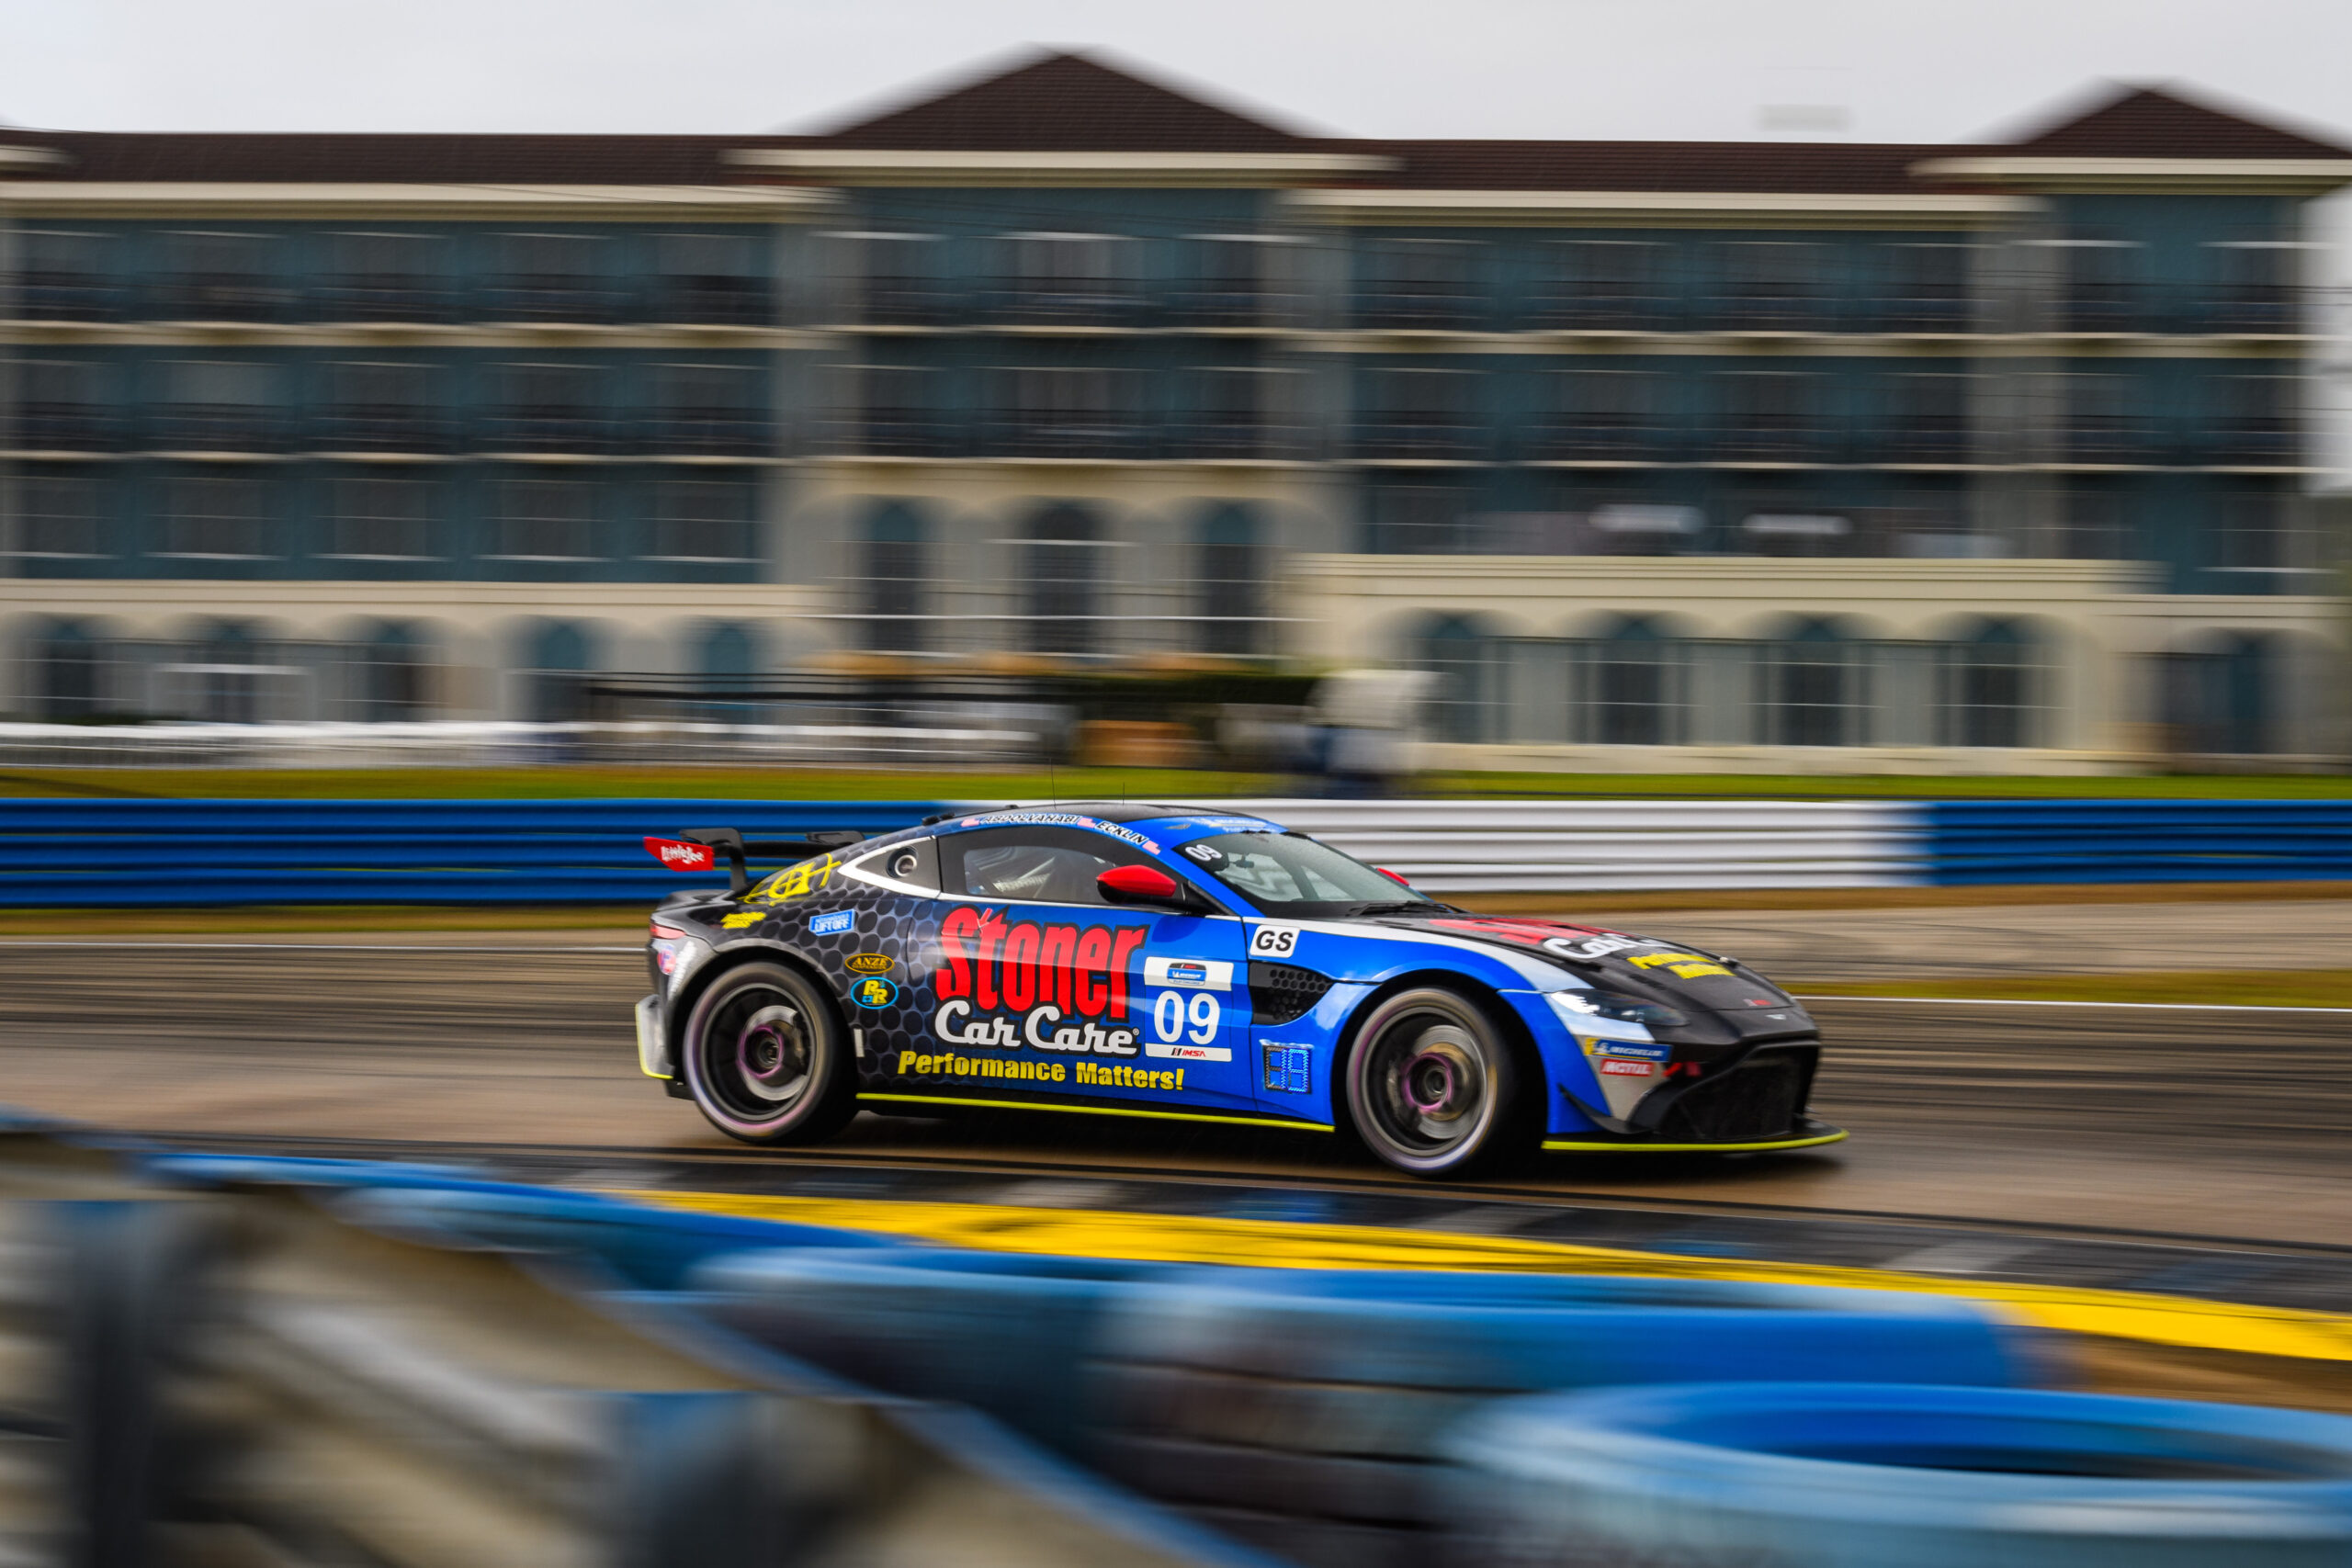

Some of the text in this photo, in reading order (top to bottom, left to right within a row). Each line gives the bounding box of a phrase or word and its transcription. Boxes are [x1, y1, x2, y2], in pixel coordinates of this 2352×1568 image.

[982, 812, 1081, 825] ABDOLVAHABI
[1096, 821, 1148, 843] ECKLIN
[1185, 844, 1223, 862] 09
[1256, 931, 1294, 952] GS
[935, 907, 1146, 1019] Stoner
[935, 1000, 1022, 1047] Car
[1154, 990, 1220, 1045] 09
[1182, 1049, 1206, 1057] IMSA
[1609, 1045, 1664, 1057] MICHELIN
[897, 1050, 1185, 1090] Performance Matters!
[1601, 1061, 1651, 1076] MOTUL
